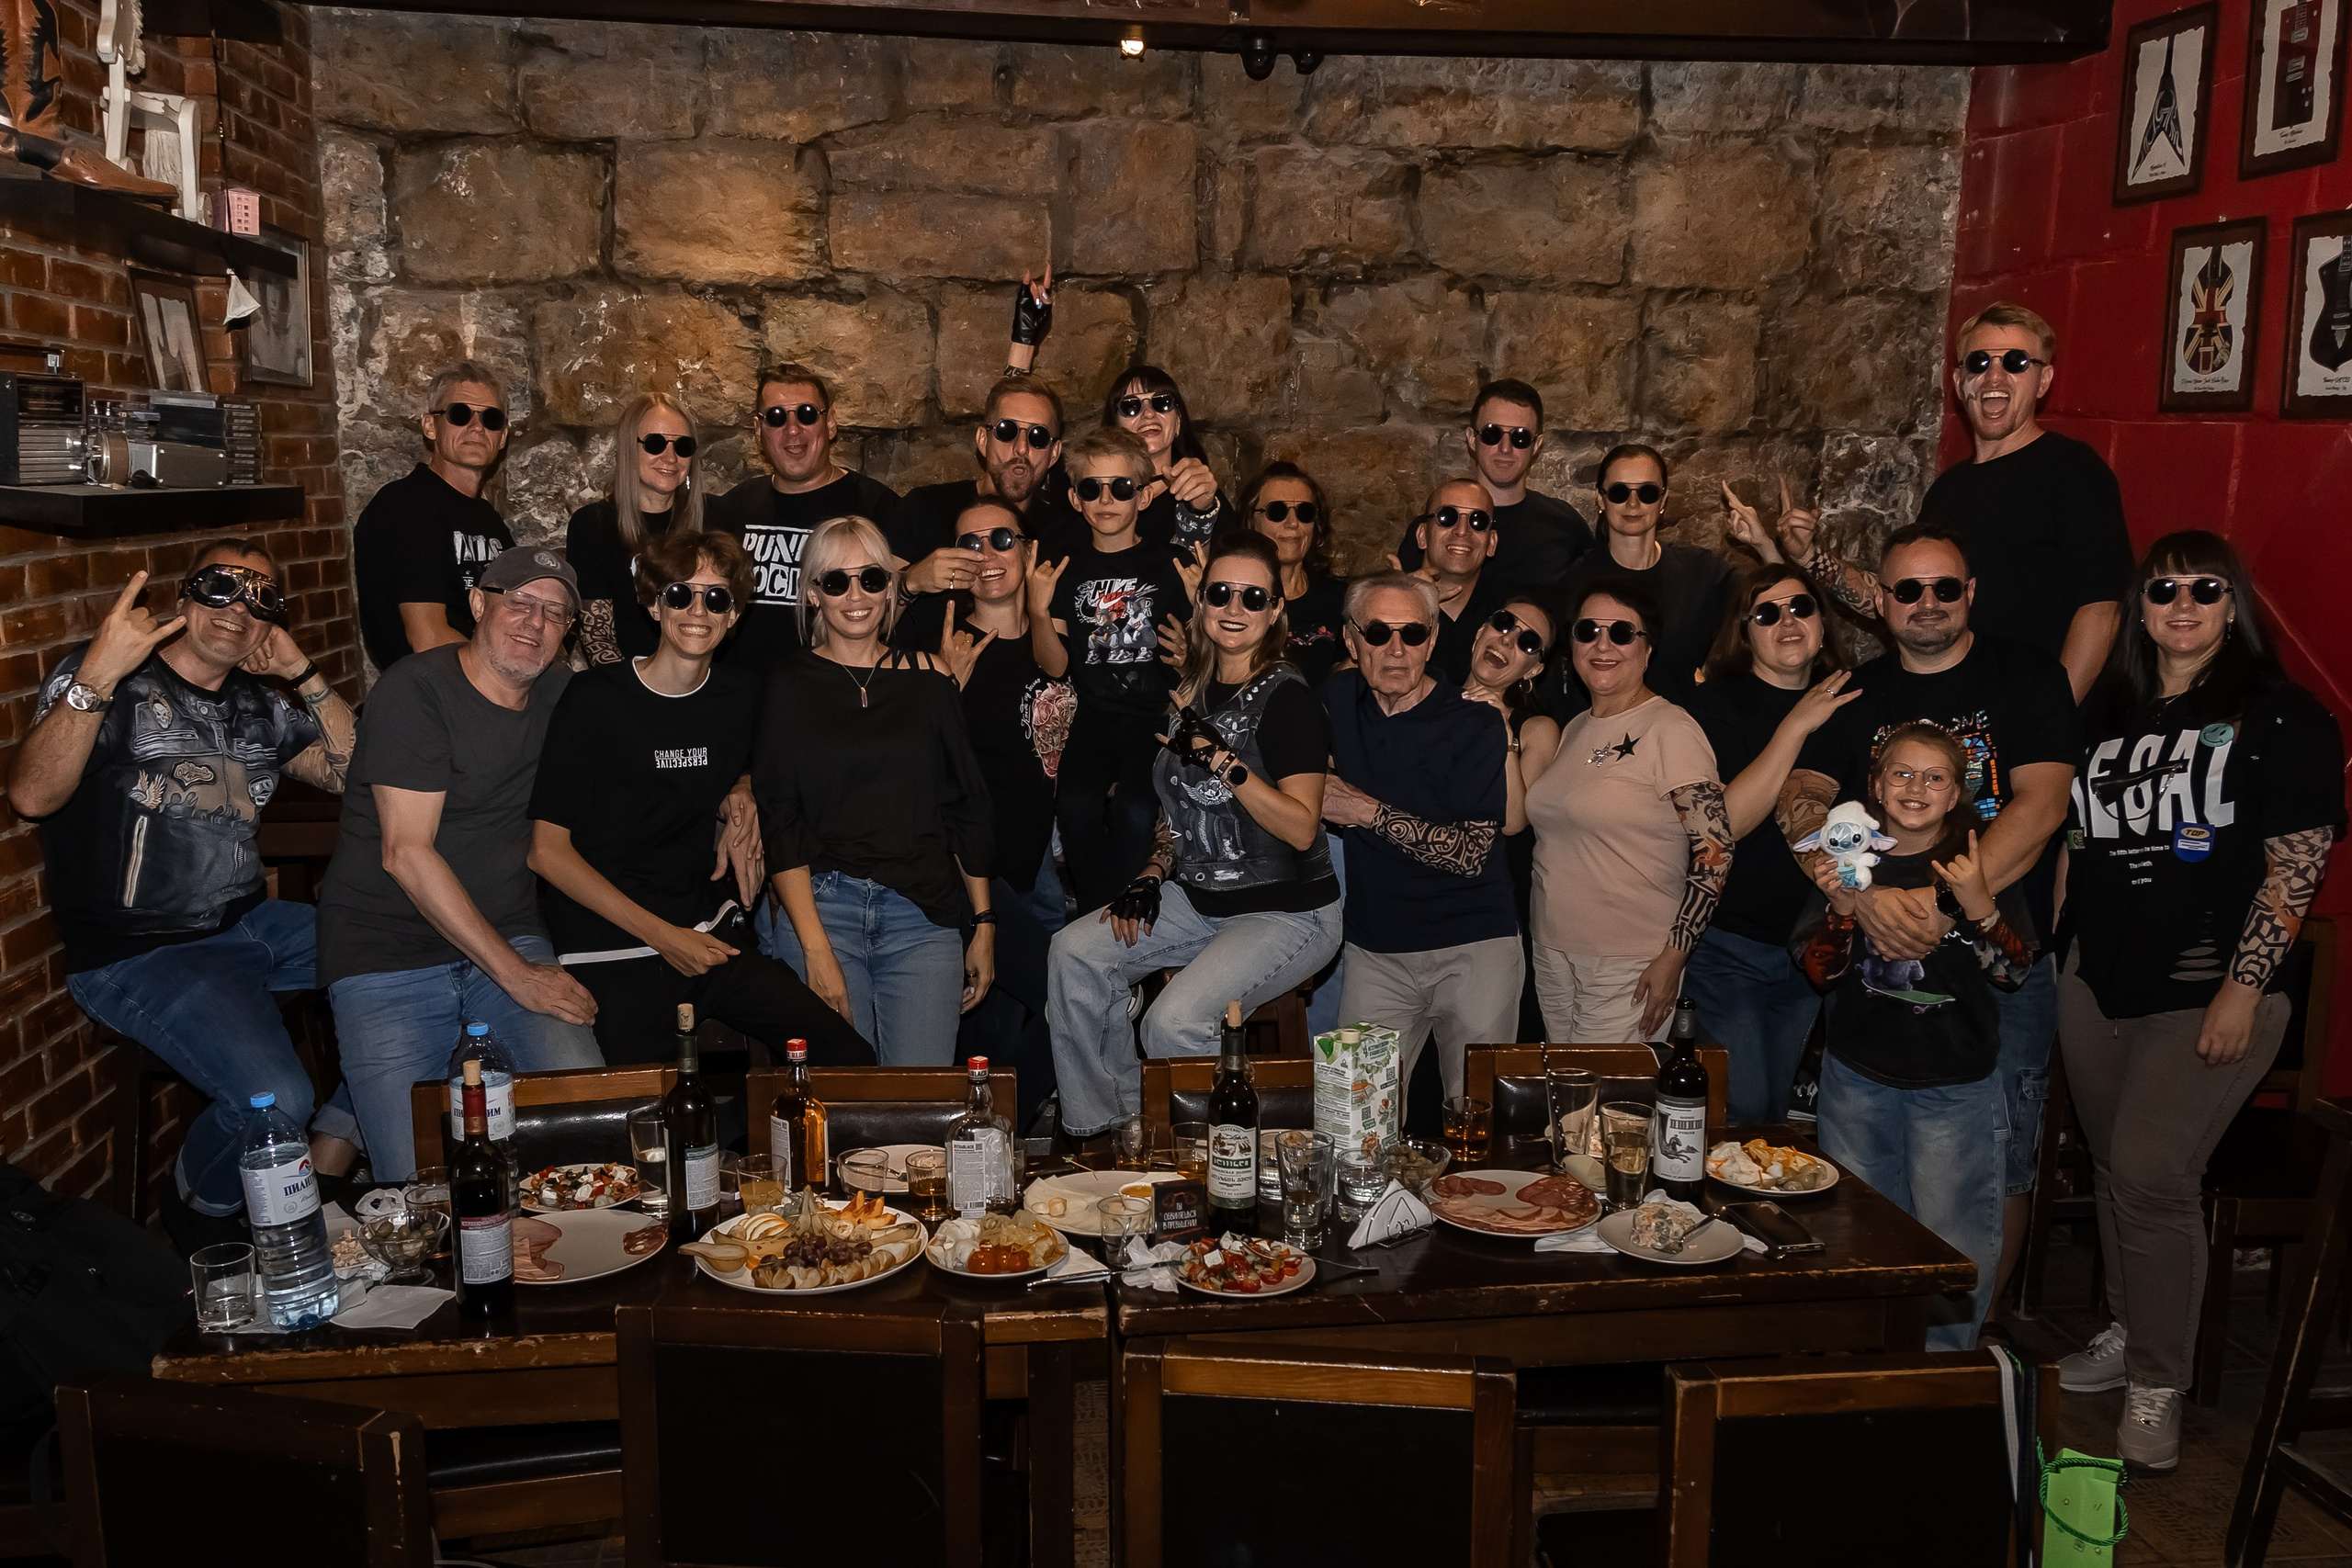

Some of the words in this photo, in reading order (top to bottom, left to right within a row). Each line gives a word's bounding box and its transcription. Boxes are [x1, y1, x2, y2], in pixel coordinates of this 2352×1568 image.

[1087, 578, 1137, 606] NIKE
[654, 749, 684, 760] CHANGE
[687, 747, 707, 757] YOUR
[655, 756, 708, 769] PERSPECTIVE
[2186, 829, 2206, 837] TOP
[1162, 1222, 1168, 1230] В
